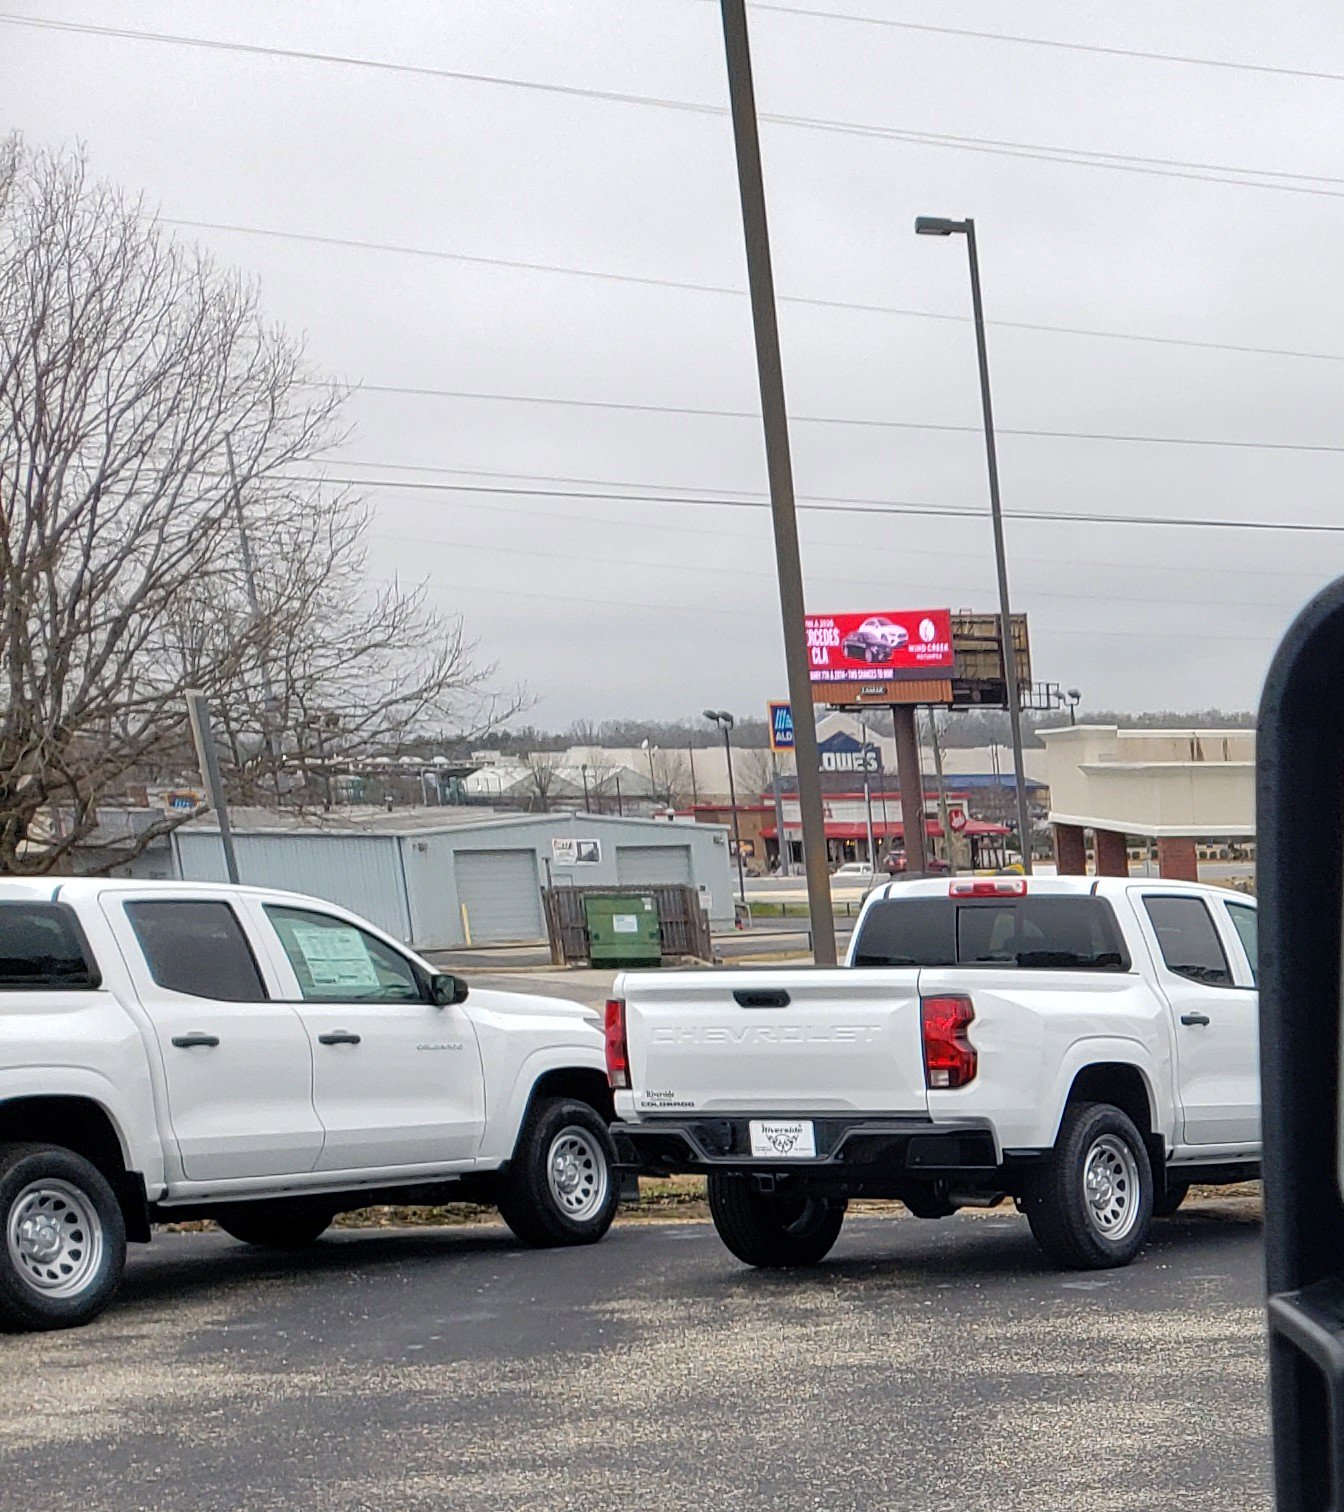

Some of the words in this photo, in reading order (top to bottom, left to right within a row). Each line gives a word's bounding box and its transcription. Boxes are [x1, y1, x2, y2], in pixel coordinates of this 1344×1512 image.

[811, 646, 829, 665] CLA
[775, 731, 793, 741] ALD
[652, 1024, 882, 1044] CHEVROLET
[761, 1123, 802, 1133] Riverside
